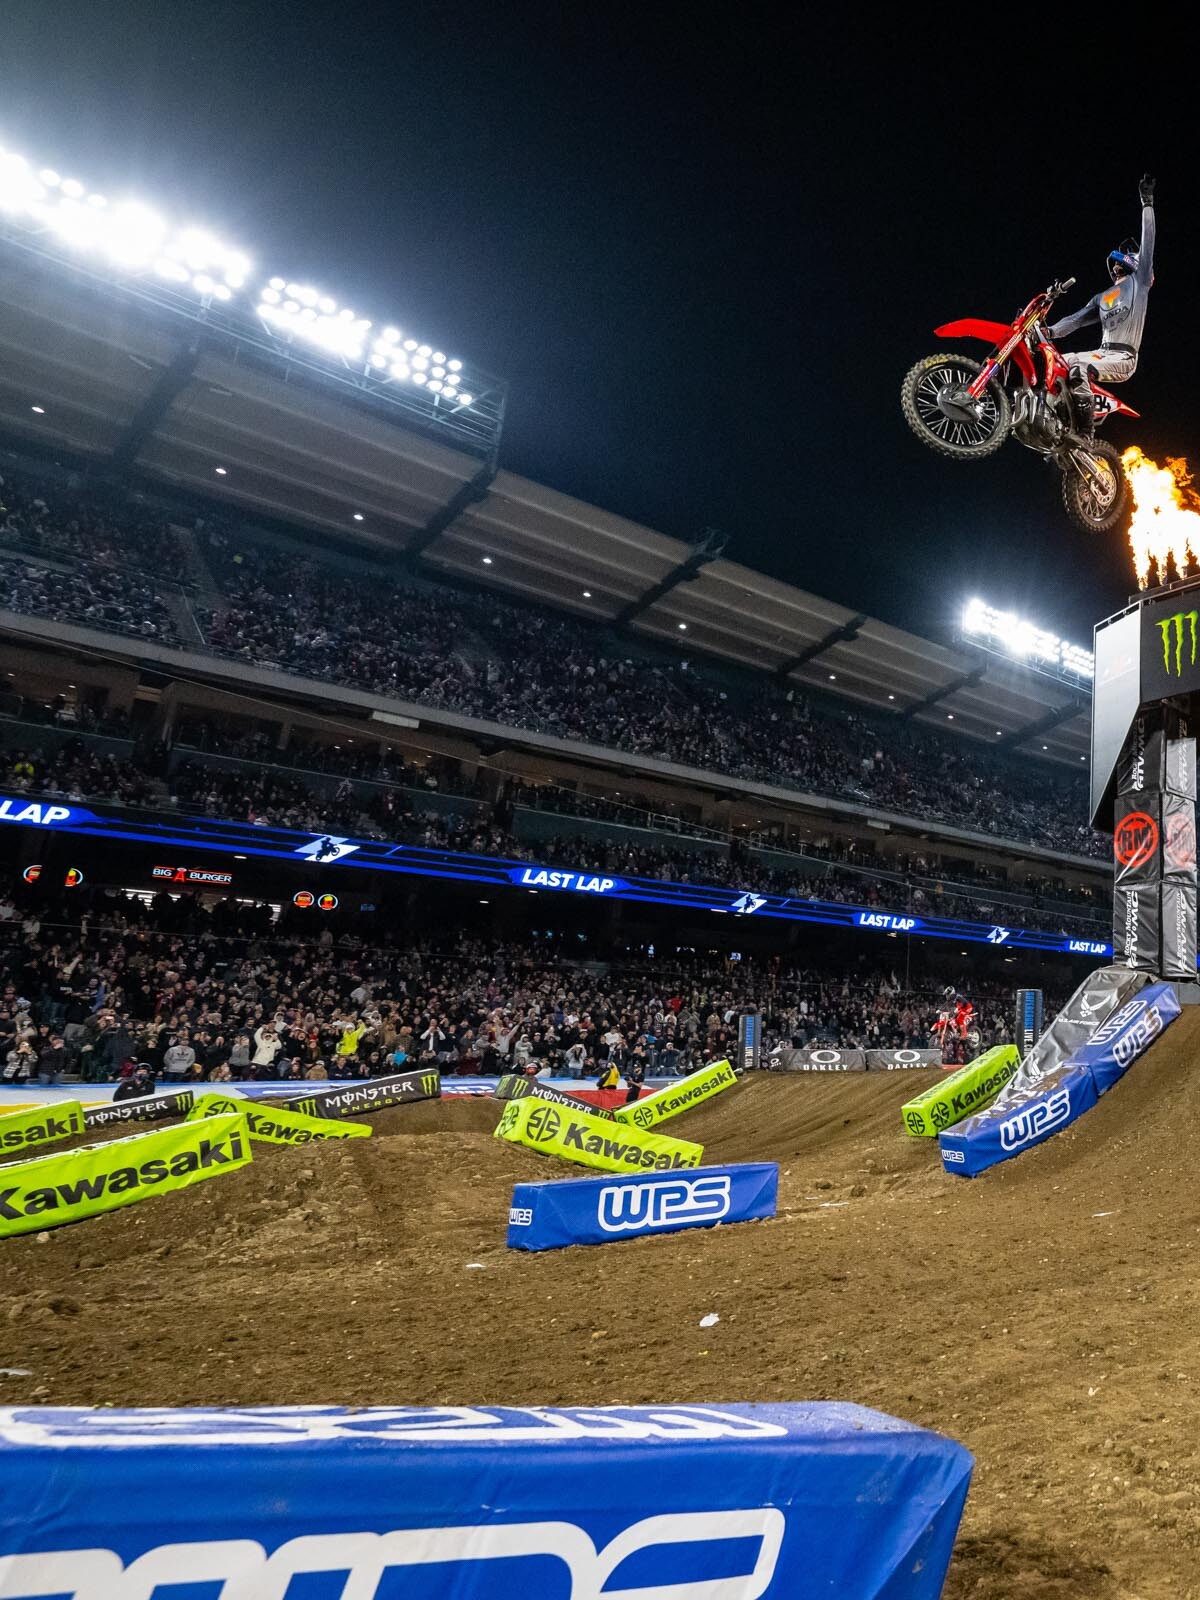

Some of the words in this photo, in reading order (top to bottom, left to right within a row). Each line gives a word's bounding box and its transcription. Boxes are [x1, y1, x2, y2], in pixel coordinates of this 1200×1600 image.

[0, 801, 70, 824] LAP
[1121, 828, 1153, 850] RM
[153, 868, 172, 876] BIG
[189, 872, 232, 882] BURGER
[522, 869, 574, 889] LAST
[576, 876, 613, 892] LAP
[860, 913, 890, 928] LAST
[892, 917, 914, 930] LAP
[1069, 940, 1090, 952] LAST
[1090, 943, 1106, 953] LAP
[1113, 1005, 1164, 1067] WPS
[325, 1081, 414, 1109] MONSTER
[531, 1086, 592, 1115] MONSTER
[656, 1066, 734, 1116] Kawasaki
[341, 1096, 403, 1114] ENERGY
[0, 1113, 79, 1149] saki
[1000, 1089, 1071, 1151] WPS
[564, 1122, 697, 1170] Kawasaki
[941, 1150, 965, 1163] WPS
[598, 1176, 731, 1232] WPS
[509, 1208, 532, 1226] WPS
